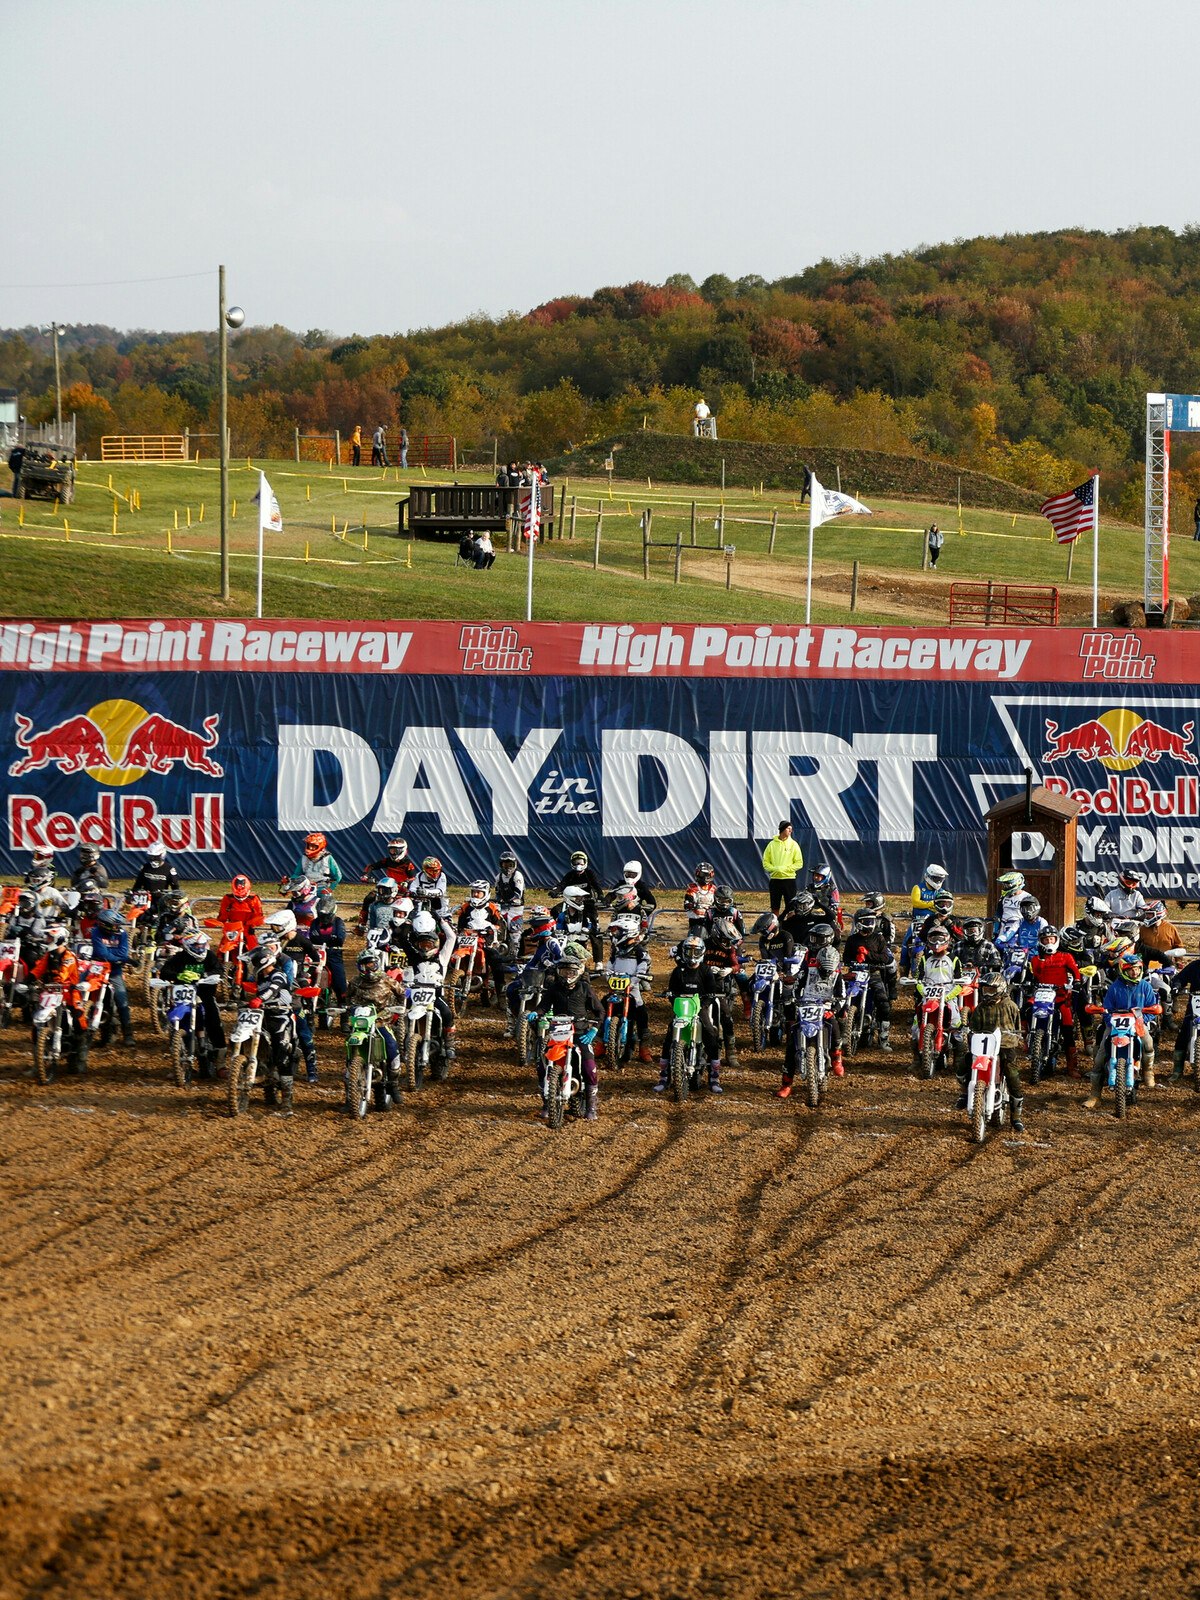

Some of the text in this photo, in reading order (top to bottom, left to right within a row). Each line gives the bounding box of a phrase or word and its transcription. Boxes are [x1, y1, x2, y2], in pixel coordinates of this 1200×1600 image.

[88, 622, 206, 663] Point
[209, 622, 413, 670] Raceway
[459, 625, 518, 651] High
[1079, 632, 1142, 658] High
[463, 647, 533, 672] Point
[579, 626, 1031, 678] High Point Raceway
[1082, 654, 1156, 679] Point
[278, 725, 938, 842] DAY in the DIRT
[1123, 775, 1199, 817] Bull
[8, 792, 226, 853] Red Bull
[1076, 871, 1119, 887] ROSS
[1139, 873, 1182, 888] RAND
[459, 937, 475, 945] 602
[756, 964, 774, 975] 135
[611, 981, 627, 990] 411
[925, 988, 944, 998] 389
[414, 991, 434, 1003] 687
[681, 1000, 688, 1014] 1
[800, 1006, 822, 1020] 354
[239, 1013, 260, 1025] 443
[1114, 1018, 1130, 1028] 14
[981, 1037, 988, 1055] 1
